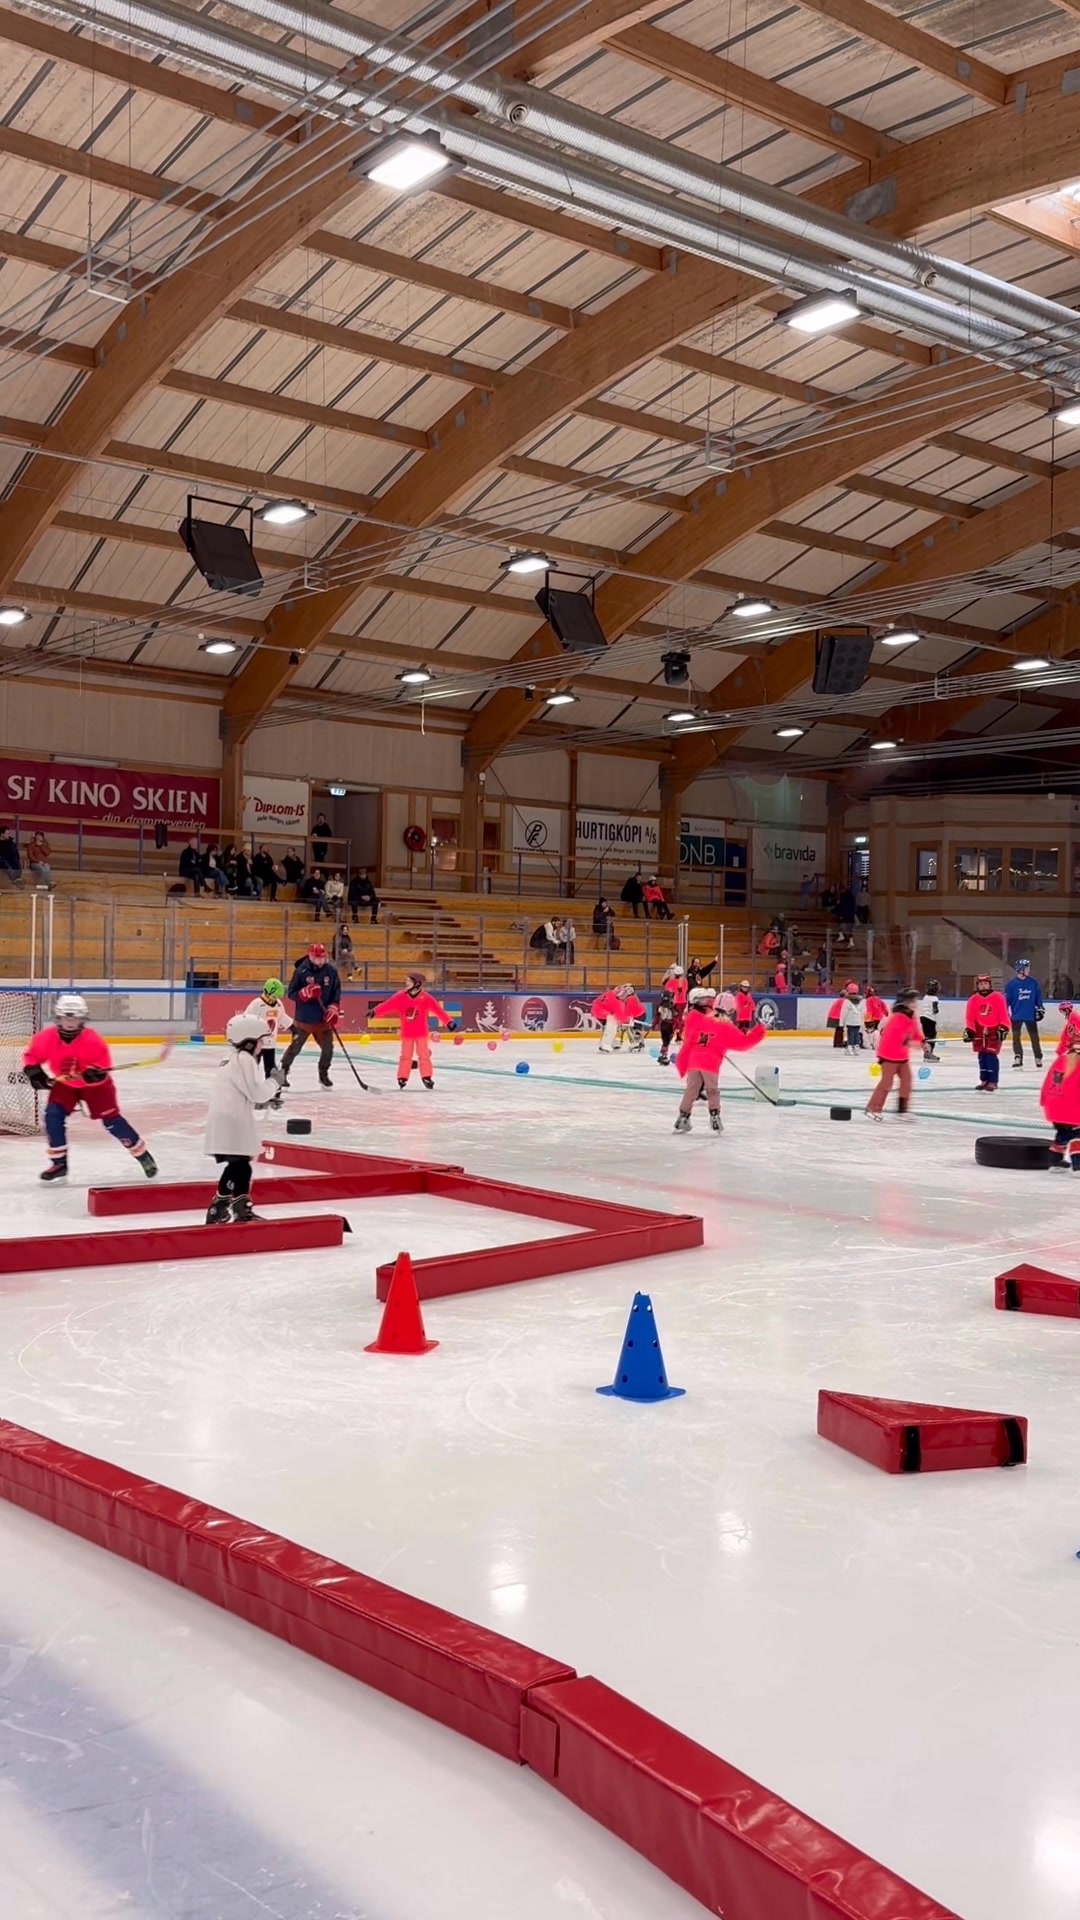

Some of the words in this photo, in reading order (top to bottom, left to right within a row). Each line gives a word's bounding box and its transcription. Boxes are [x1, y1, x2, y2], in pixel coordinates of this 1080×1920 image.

[7, 774, 36, 801] SF
[48, 778, 120, 808] KINO
[132, 786, 208, 816] SKIEN
[575, 820, 642, 843] HURTIGKOPI
[645, 826, 657, 845] A/S
[679, 841, 716, 865] DNB
[774, 843, 816, 862] bravida
